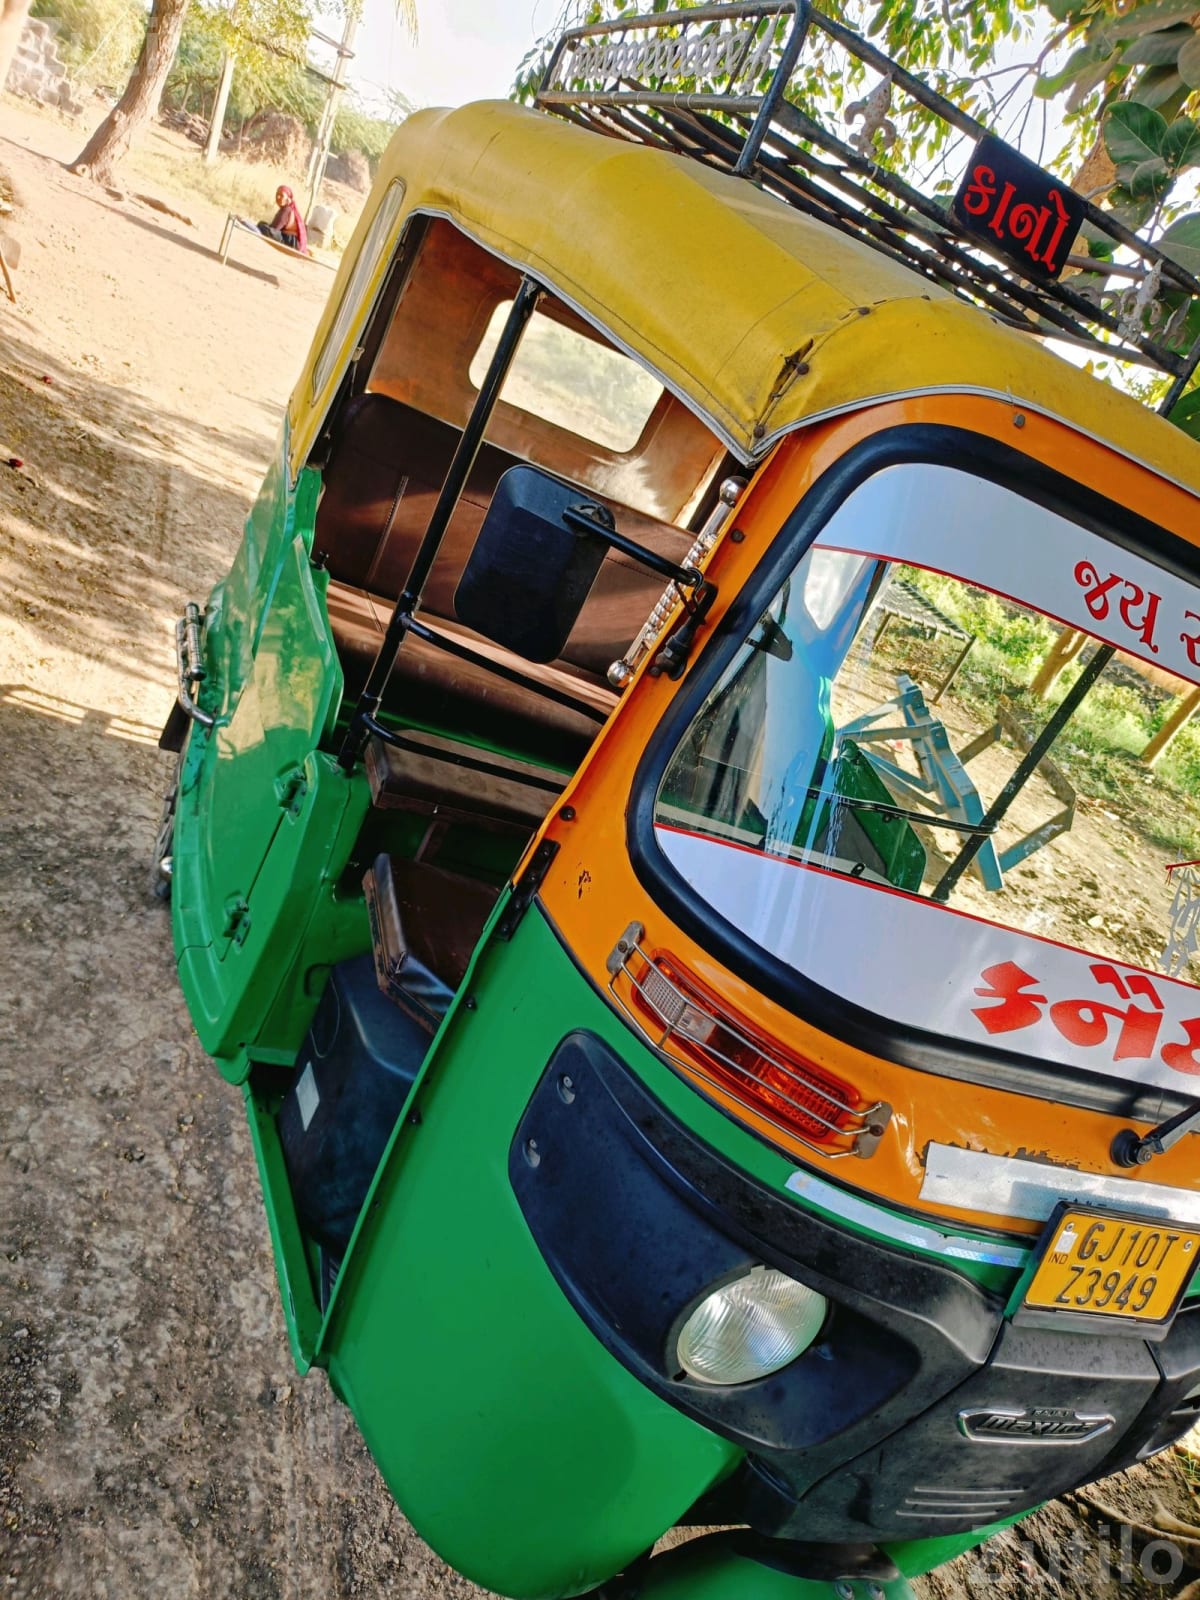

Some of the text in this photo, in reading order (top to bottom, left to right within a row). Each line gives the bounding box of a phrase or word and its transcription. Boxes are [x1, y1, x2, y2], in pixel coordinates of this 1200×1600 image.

[963, 164, 1071, 272] કાનો
[1073, 560, 1162, 654] જય
[1047, 1253, 1069, 1265] IND
[1055, 1265, 1158, 1312] Z3949
